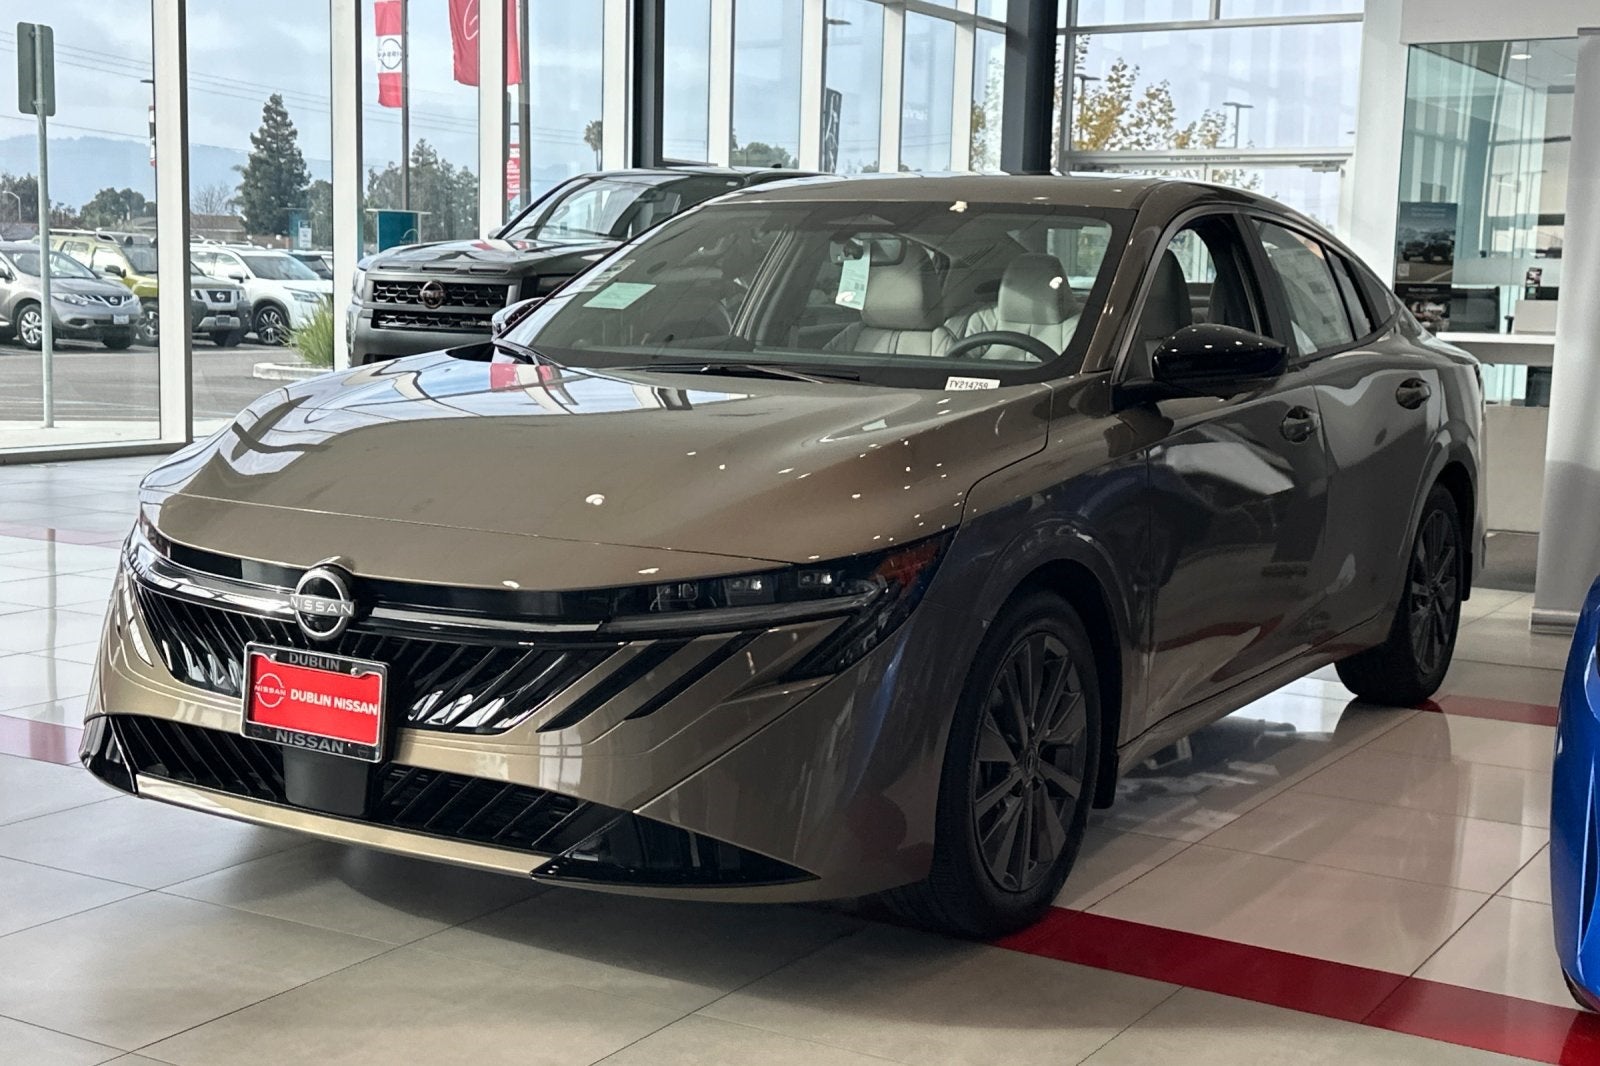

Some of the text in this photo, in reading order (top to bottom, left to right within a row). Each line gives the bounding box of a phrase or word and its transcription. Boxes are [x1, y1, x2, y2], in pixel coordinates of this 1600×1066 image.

[290, 596, 352, 614] NISSAN
[290, 652, 341, 671] DUBLIN
[254, 684, 286, 697] NISSAN
[290, 689, 378, 715] DUBLIN NISSAN
[276, 731, 344, 754] NISSAN
